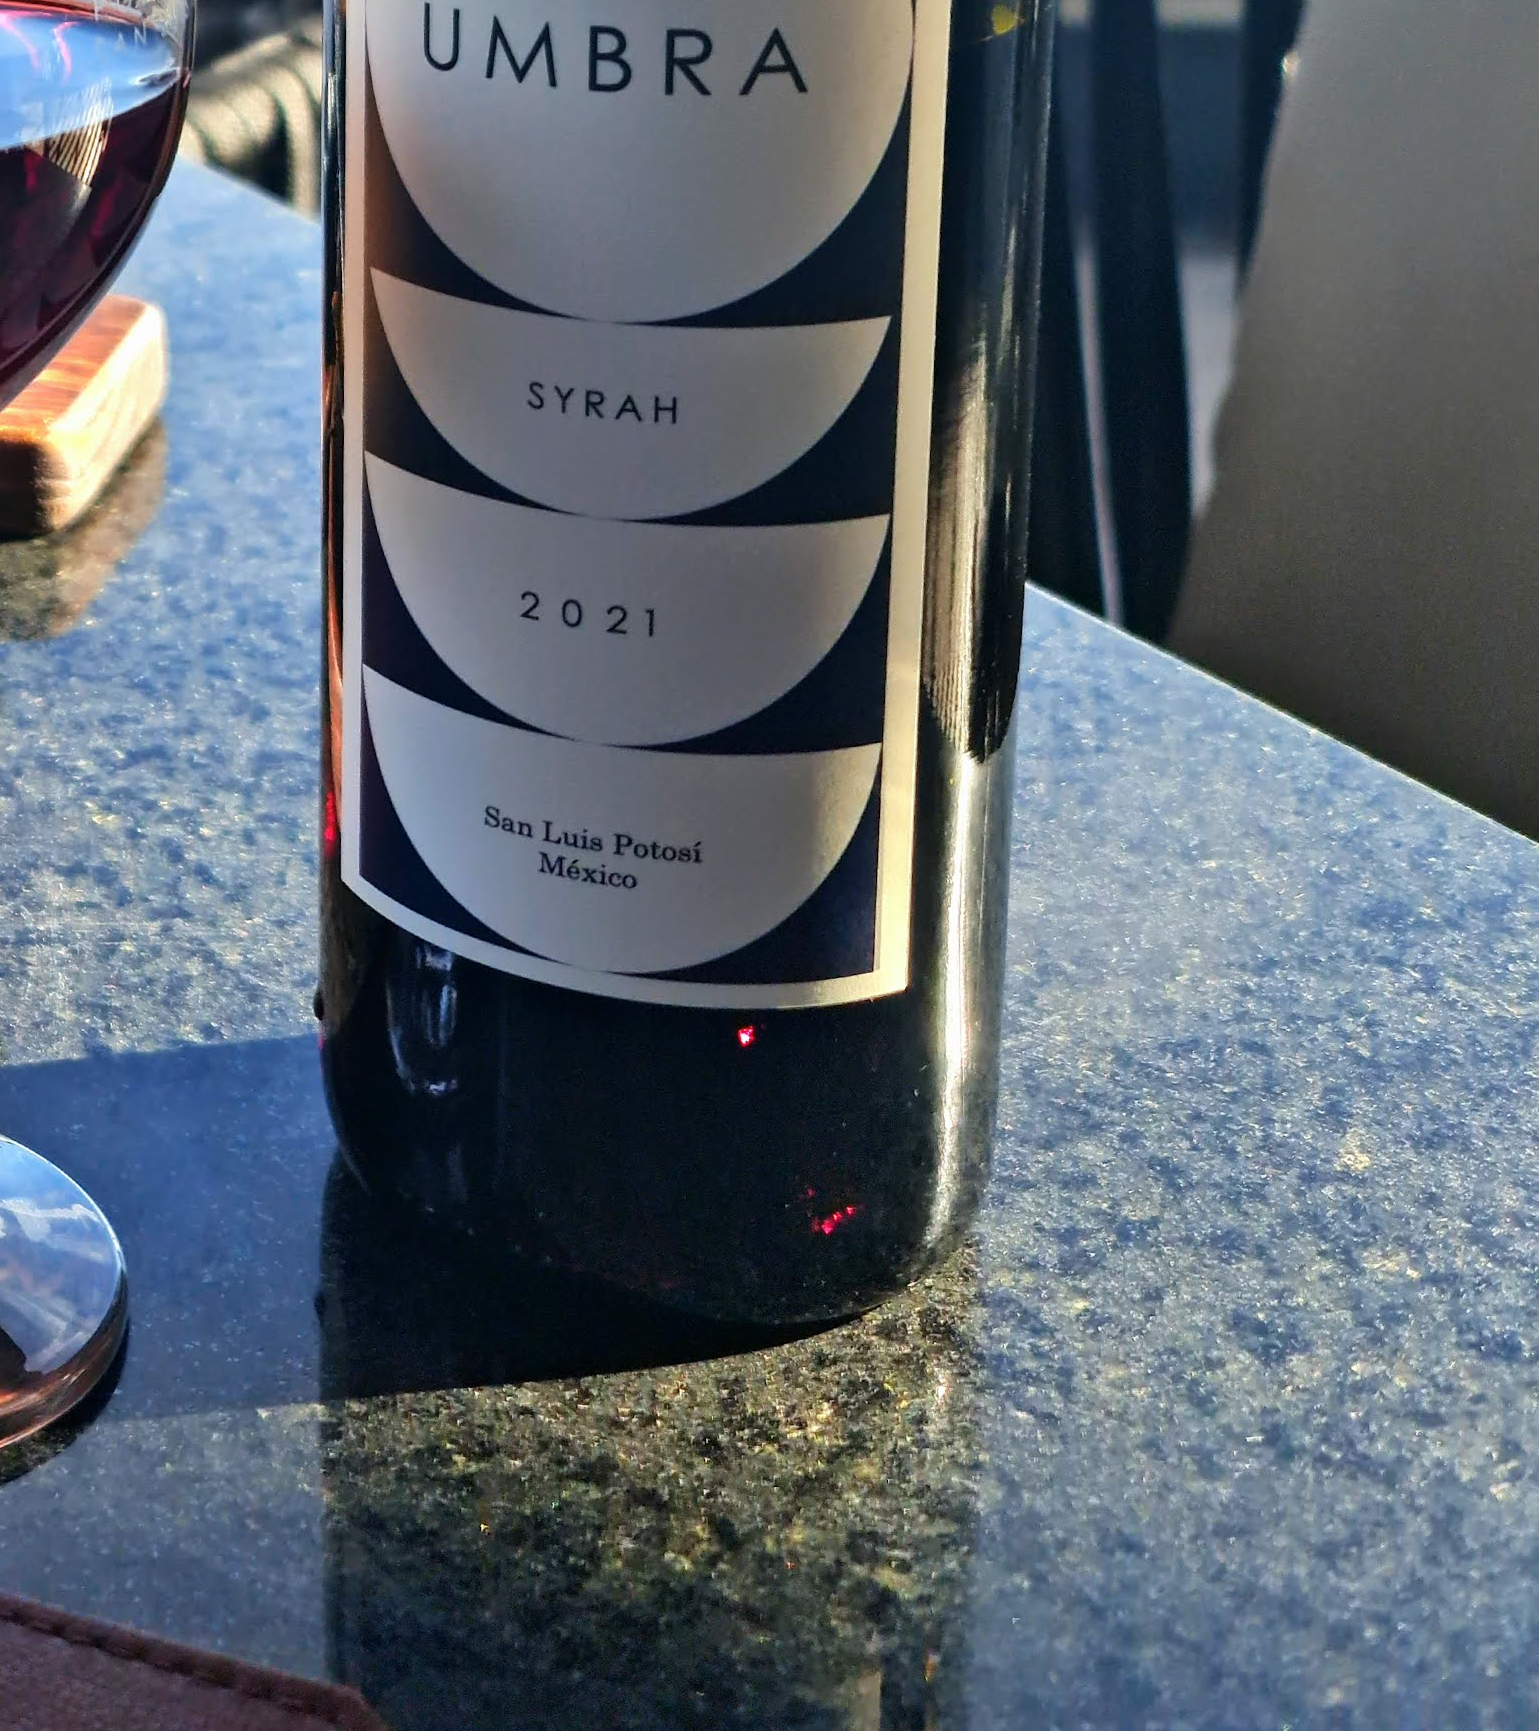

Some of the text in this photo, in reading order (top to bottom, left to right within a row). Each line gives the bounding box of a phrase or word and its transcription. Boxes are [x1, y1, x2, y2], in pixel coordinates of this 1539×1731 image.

[422, 1, 809, 97] UMBRA
[526, 380, 678, 425] SYRAH
[519, 590, 655, 638] 2021
[483, 804, 704, 864] San Luis Potosí
[537, 850, 638, 890] México
